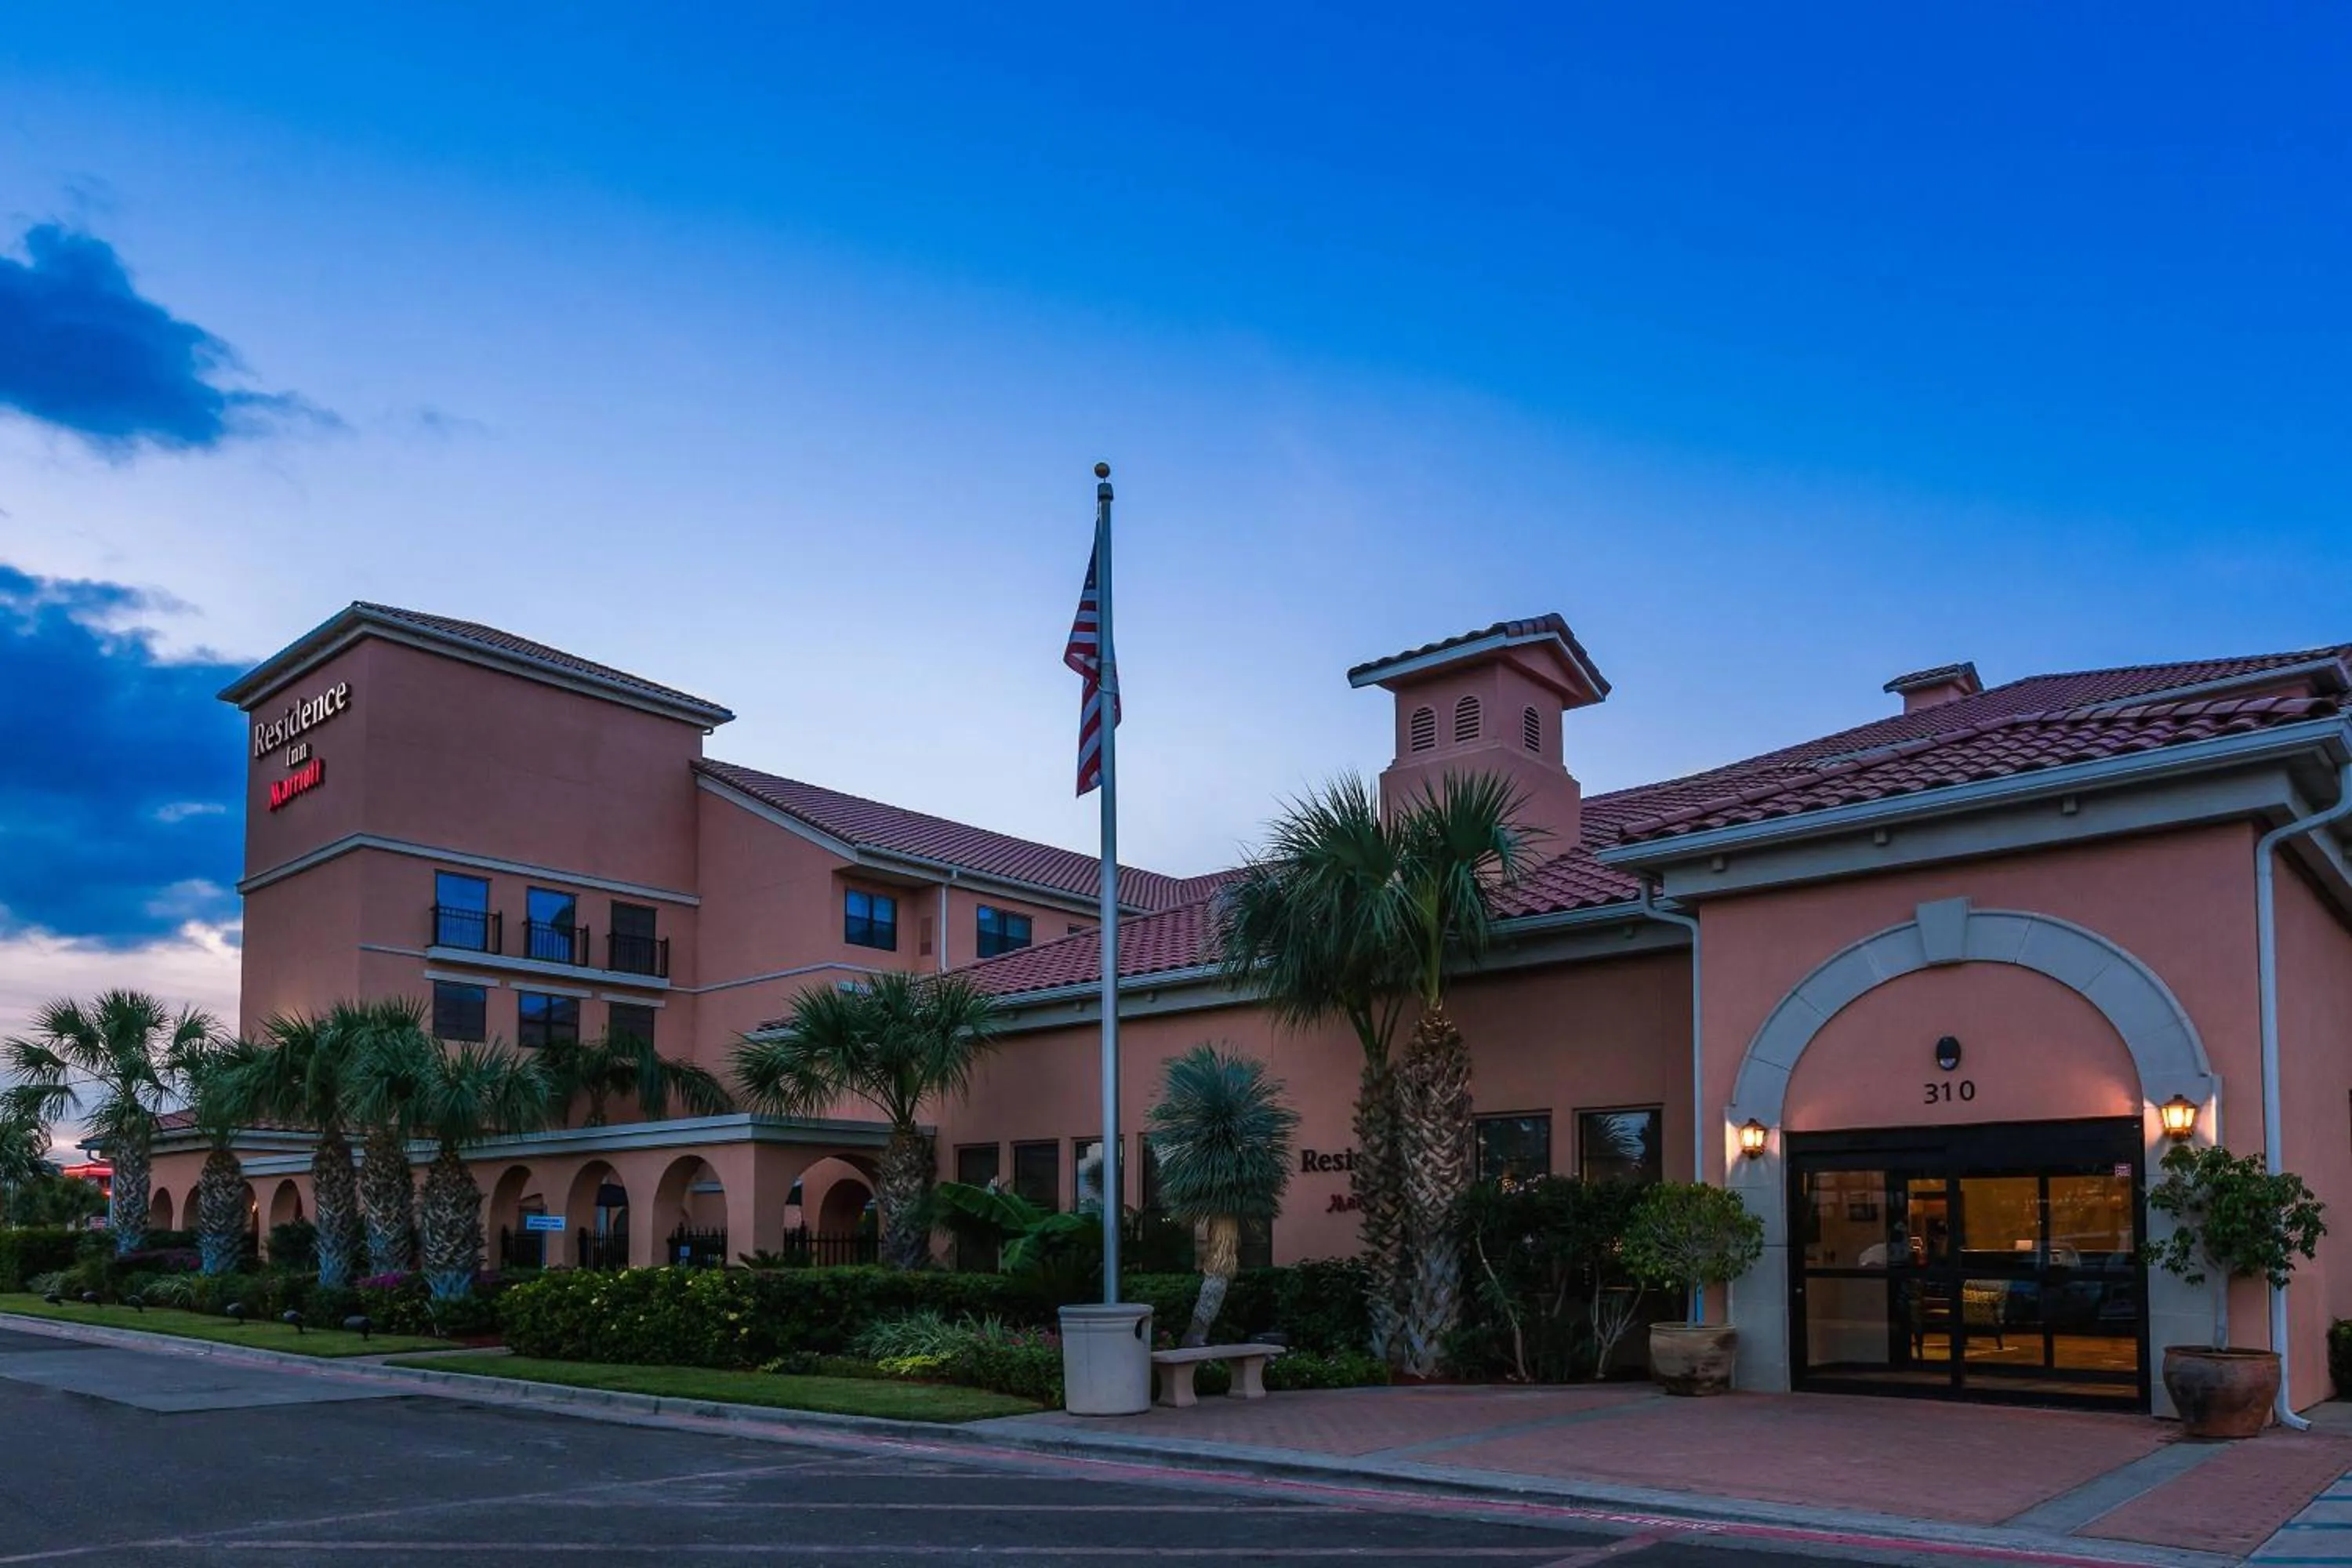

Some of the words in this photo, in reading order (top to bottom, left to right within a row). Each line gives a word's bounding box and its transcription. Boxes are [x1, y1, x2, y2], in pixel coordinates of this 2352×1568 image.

[254, 681, 347, 757] Residence
[285, 742, 307, 767] Inn
[269, 757, 322, 808] Marriott
[1923, 1080, 1976, 1105] 310
[1301, 1147, 1353, 1173] Resi
